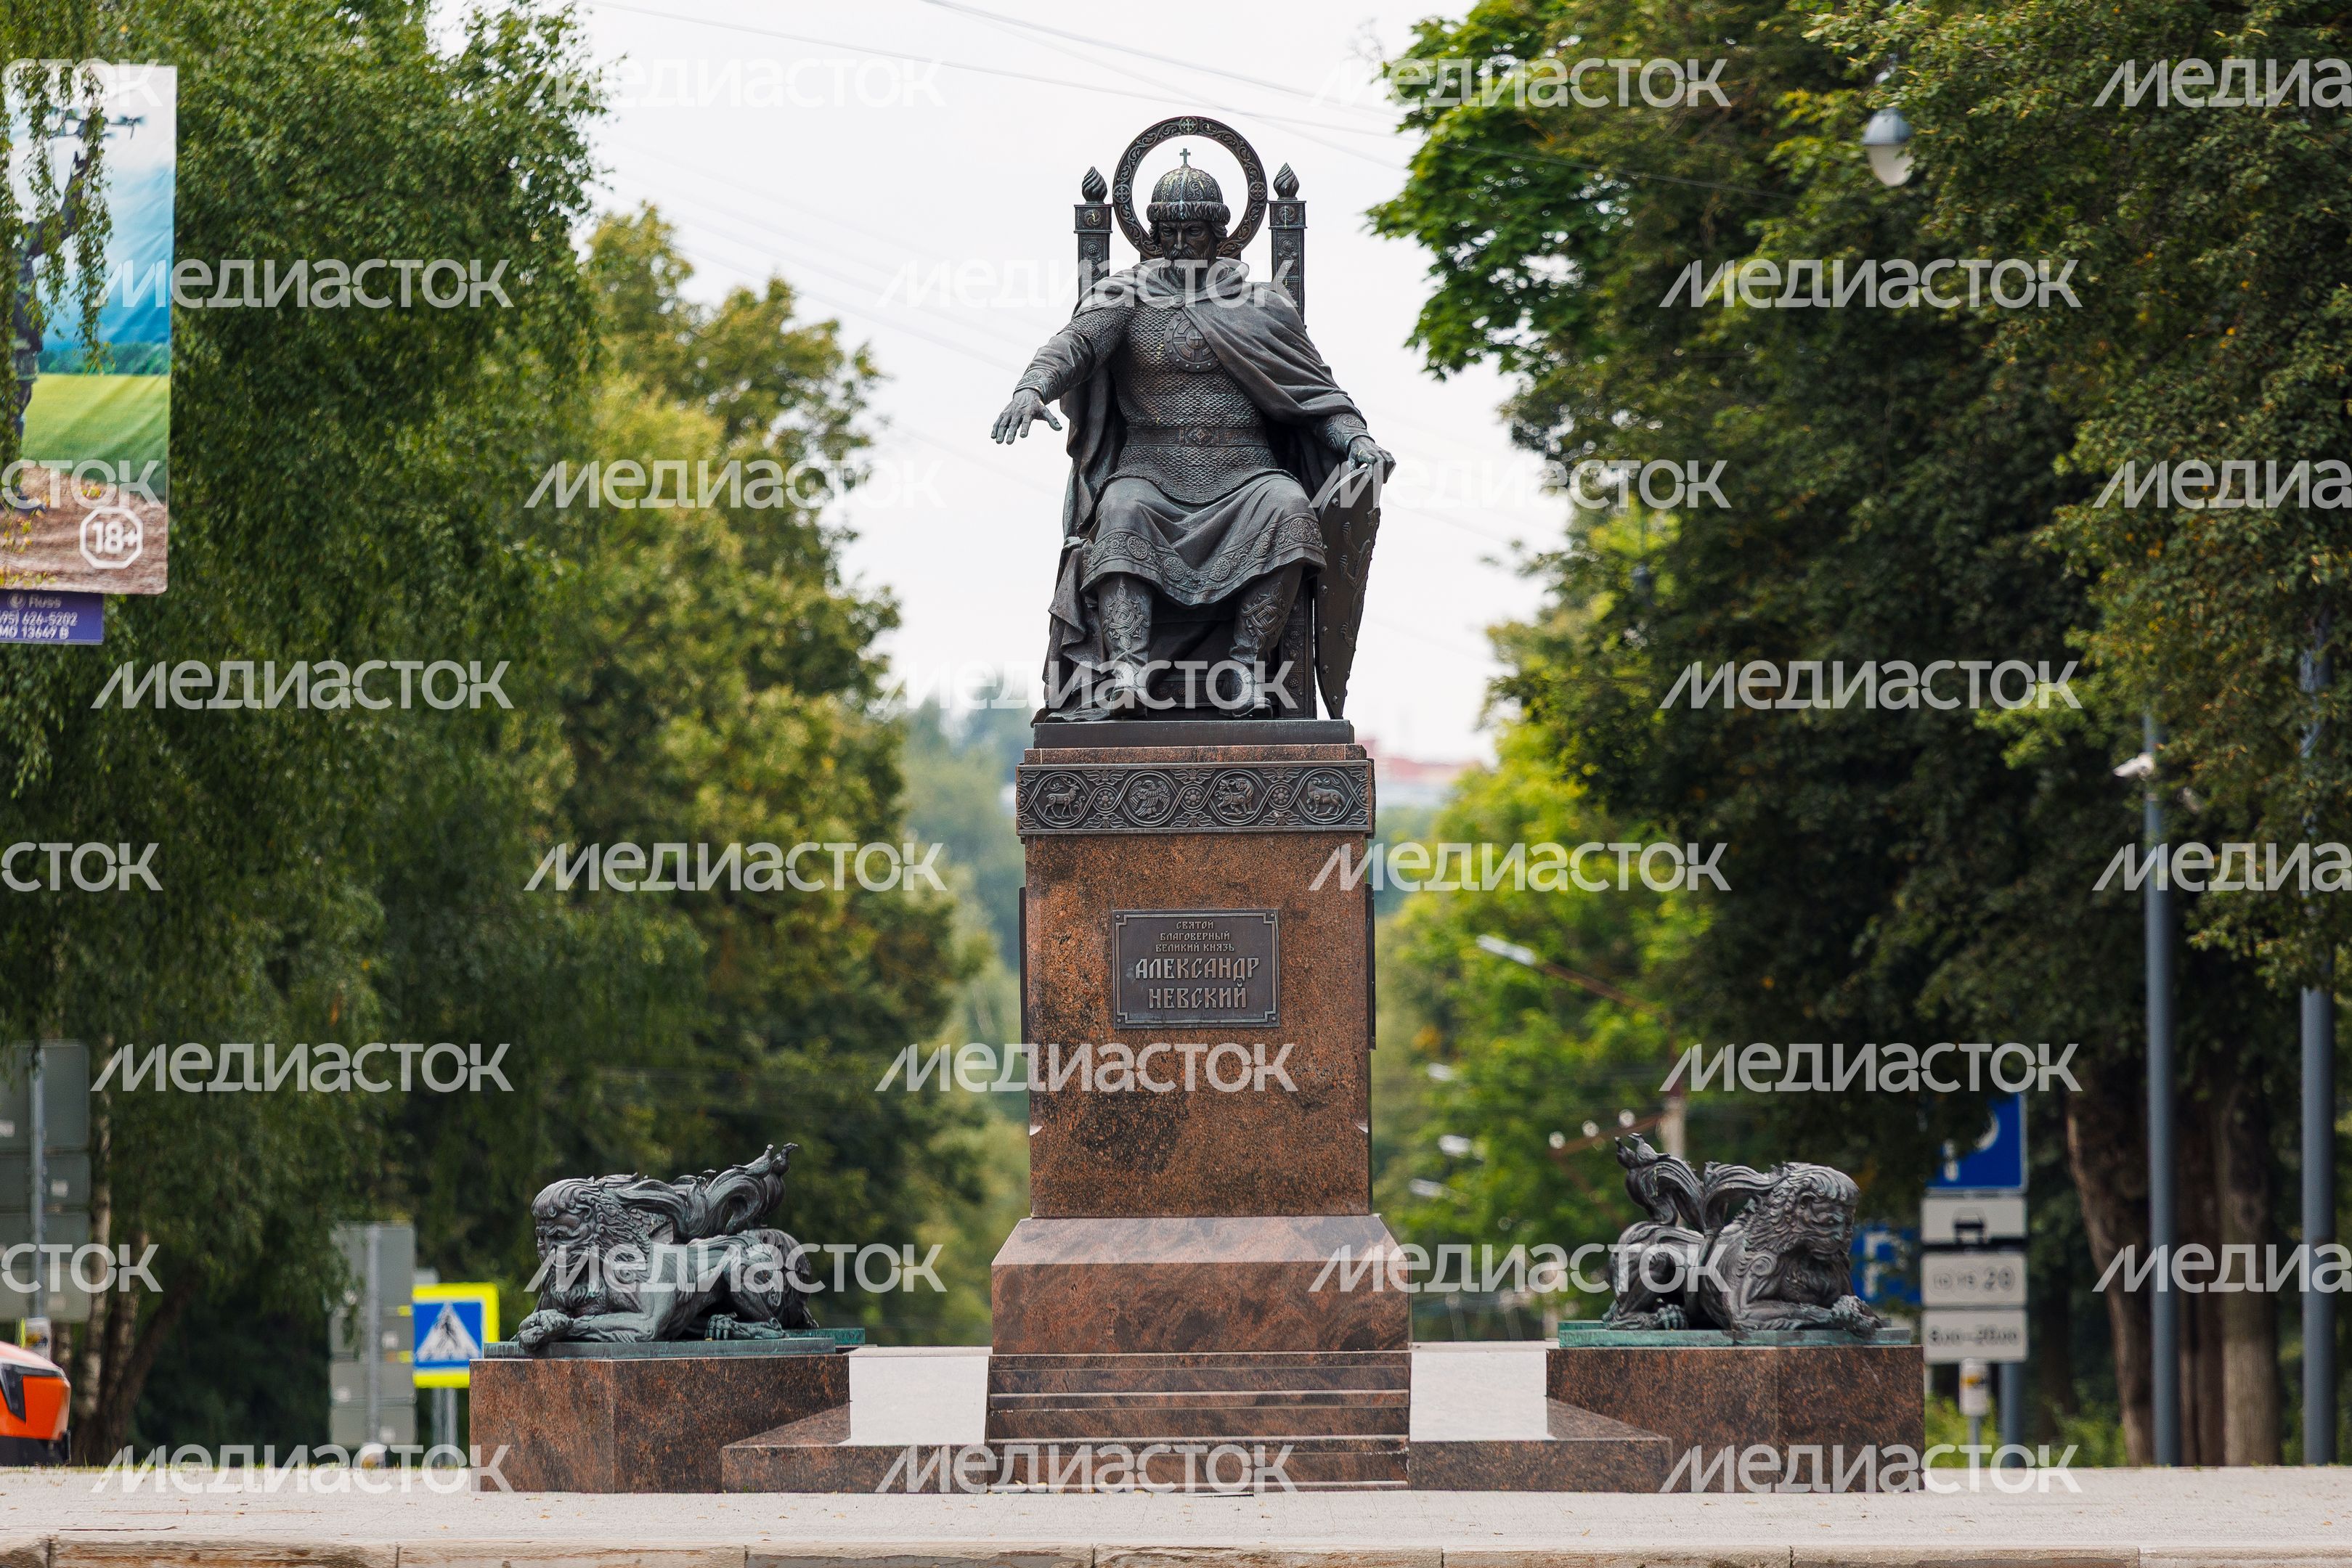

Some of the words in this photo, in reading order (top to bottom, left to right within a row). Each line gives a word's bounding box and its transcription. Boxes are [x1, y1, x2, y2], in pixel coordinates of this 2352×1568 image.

[91, 521, 138, 555] 18+
[21, 611, 78, 627] 626-5202
[1176, 920, 1214, 929] СВЯТОЙ
[1160, 930, 1230, 941] БЛАГОВЕРНЫЙ
[1155, 942, 1200, 952] ВЕЛИКИЙ
[1203, 943, 1234, 952] КНЯЗЬ
[1135, 957, 1260, 982] АЛЕКСАНДР
[1148, 980, 1247, 1009] НЕВСКИЙ
